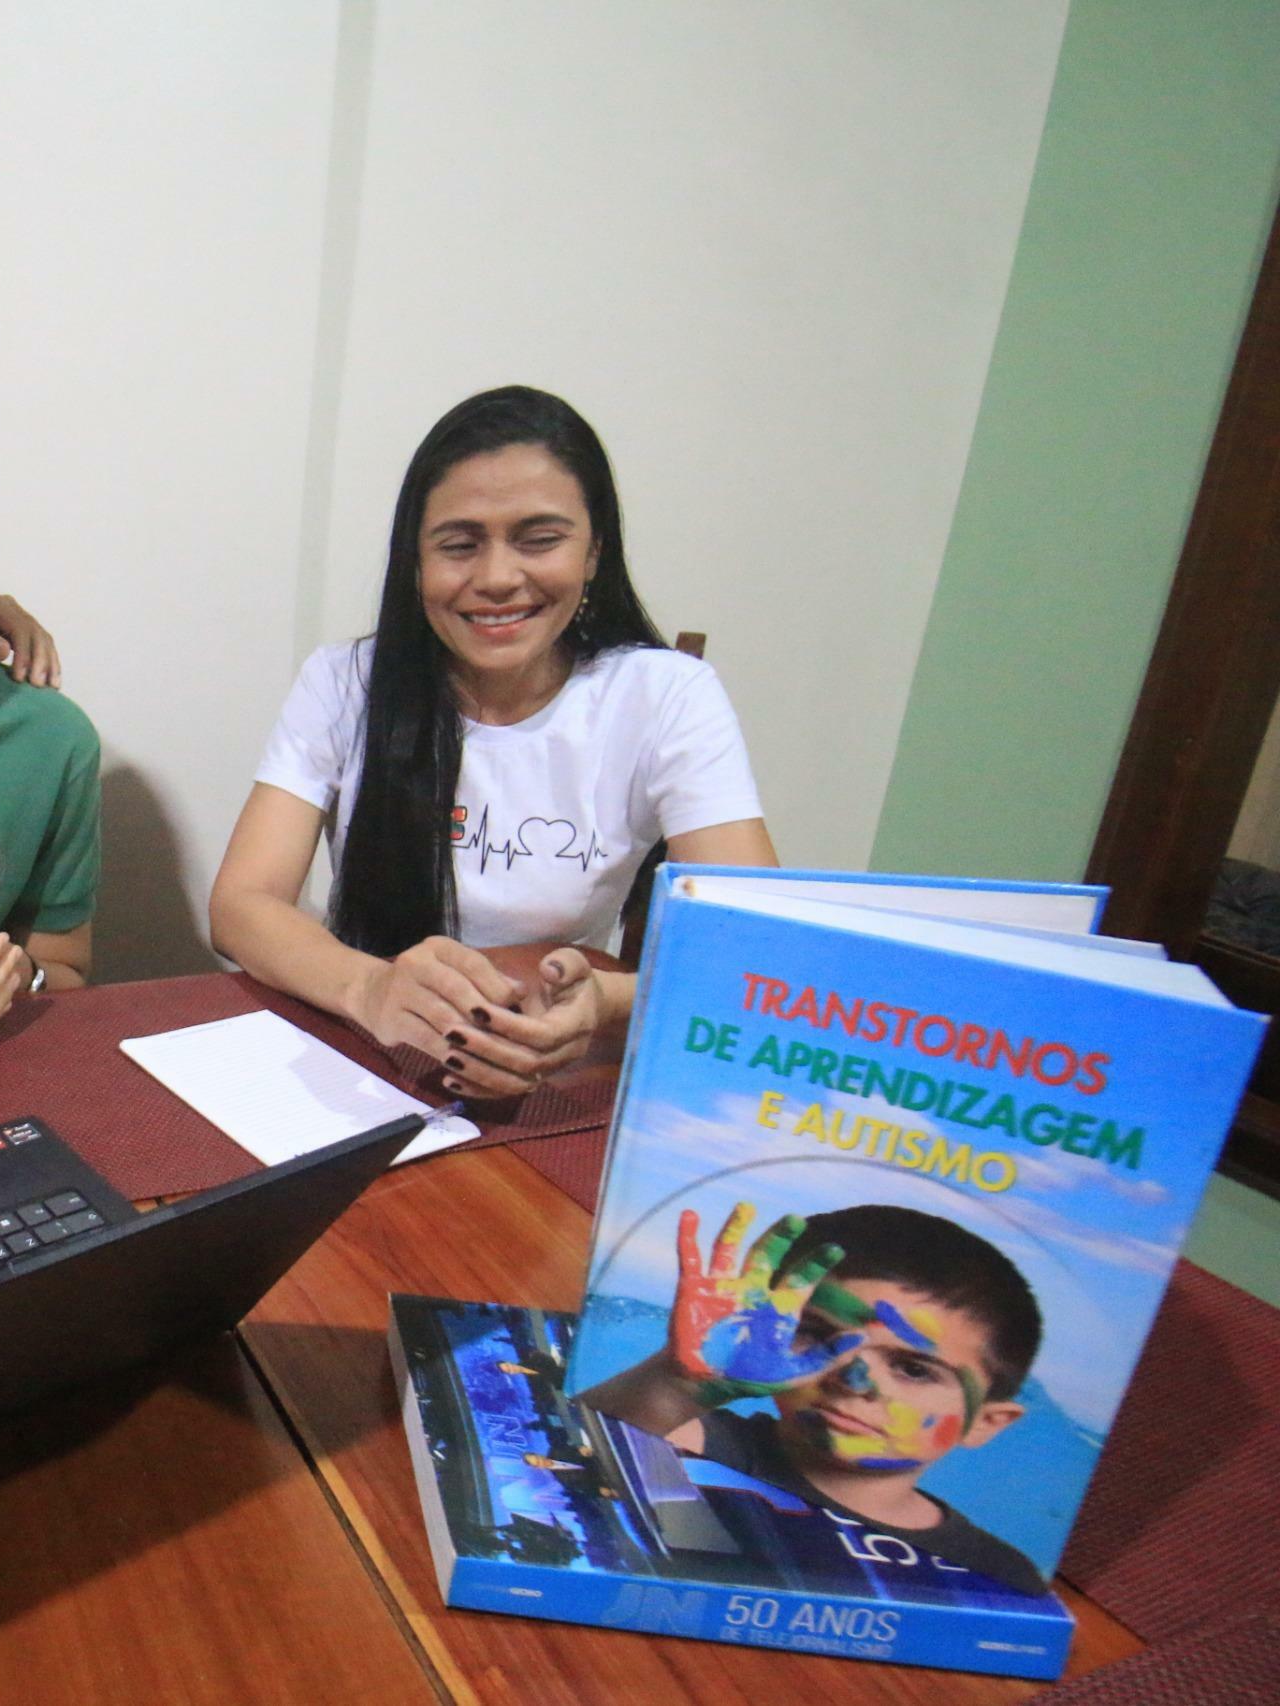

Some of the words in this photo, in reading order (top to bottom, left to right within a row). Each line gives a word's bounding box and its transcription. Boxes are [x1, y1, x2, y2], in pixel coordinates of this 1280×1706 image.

[742, 972, 1111, 1096] TRANSTORNOS
[684, 1015, 741, 1062] DE
[748, 1034, 1145, 1170] APRENDIZAGEM
[756, 1090, 785, 1129] E
[792, 1103, 1017, 1193] AUTISMO
[725, 1595, 779, 1628] 50
[789, 1603, 901, 1642] ANOS
